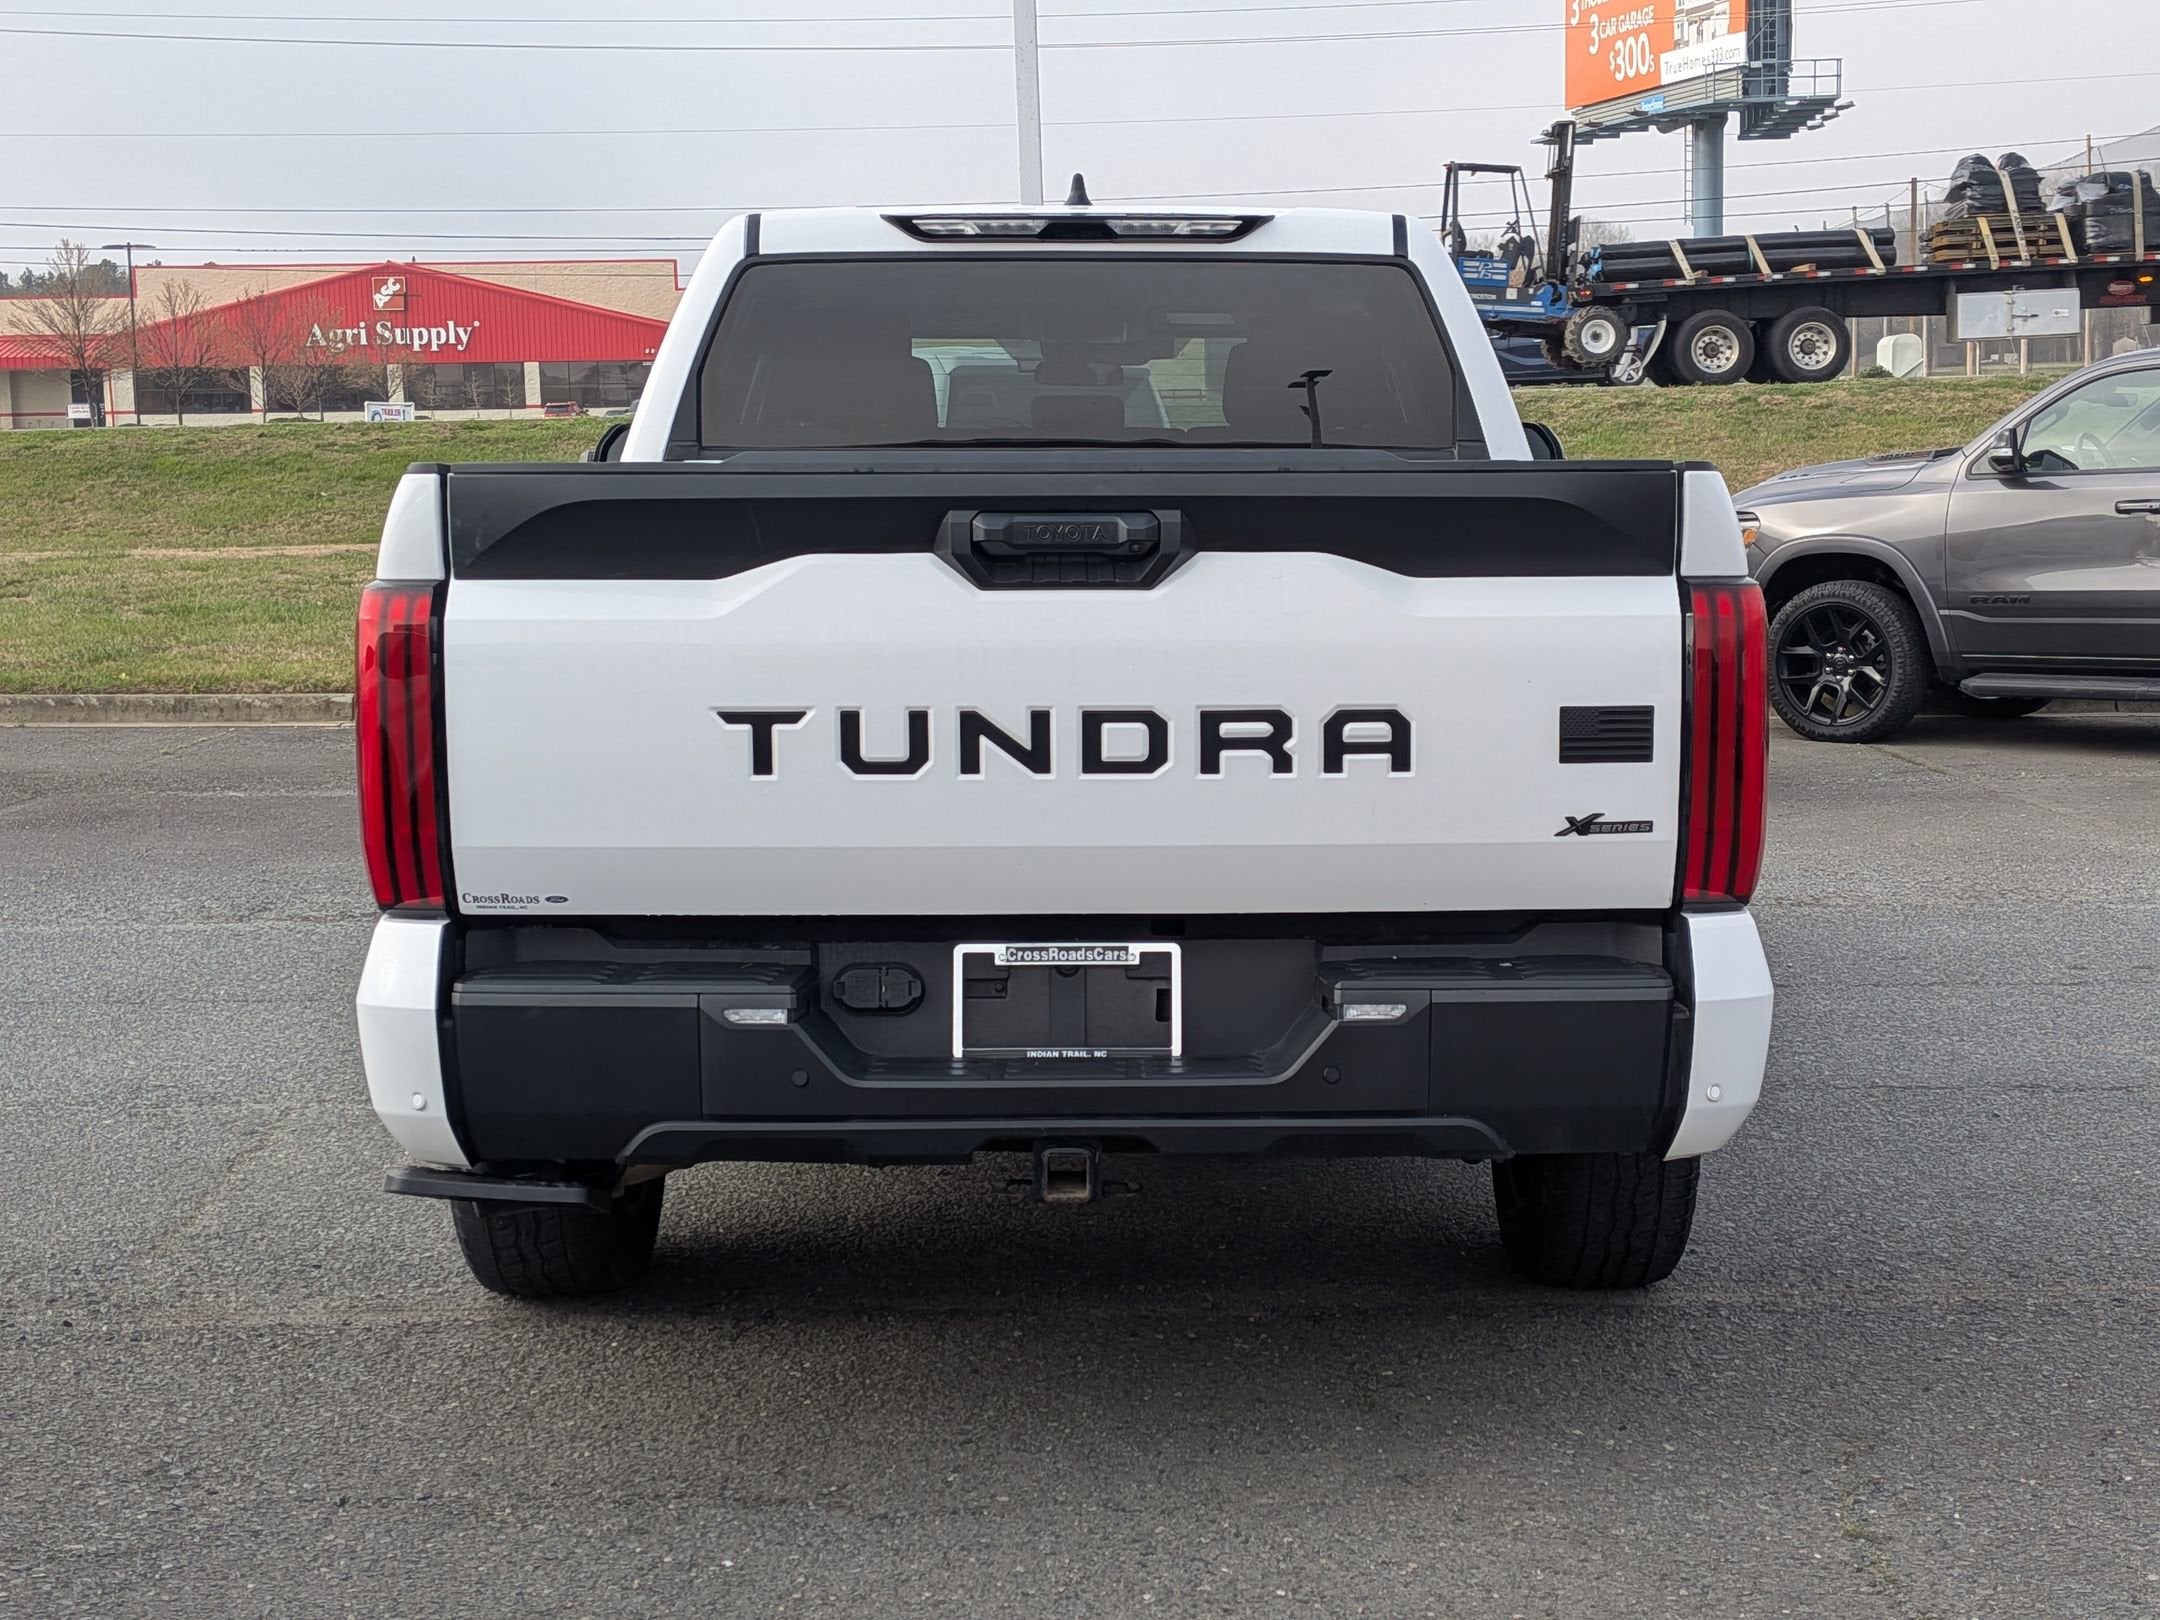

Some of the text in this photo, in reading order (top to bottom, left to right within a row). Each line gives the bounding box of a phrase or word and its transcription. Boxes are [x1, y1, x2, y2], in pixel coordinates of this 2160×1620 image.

[1589, 5, 1655, 54] 3 CAR GARAGE
[1664, 47, 1741, 75] TrueHomes333.com
[306, 320, 473, 352] Agri Supply
[1023, 525, 1107, 541] TOYOTA
[1969, 595, 2031, 605] RAM
[713, 708, 1412, 776] TUNDRA
[1006, 948, 1126, 961] CrossRoadsCars
